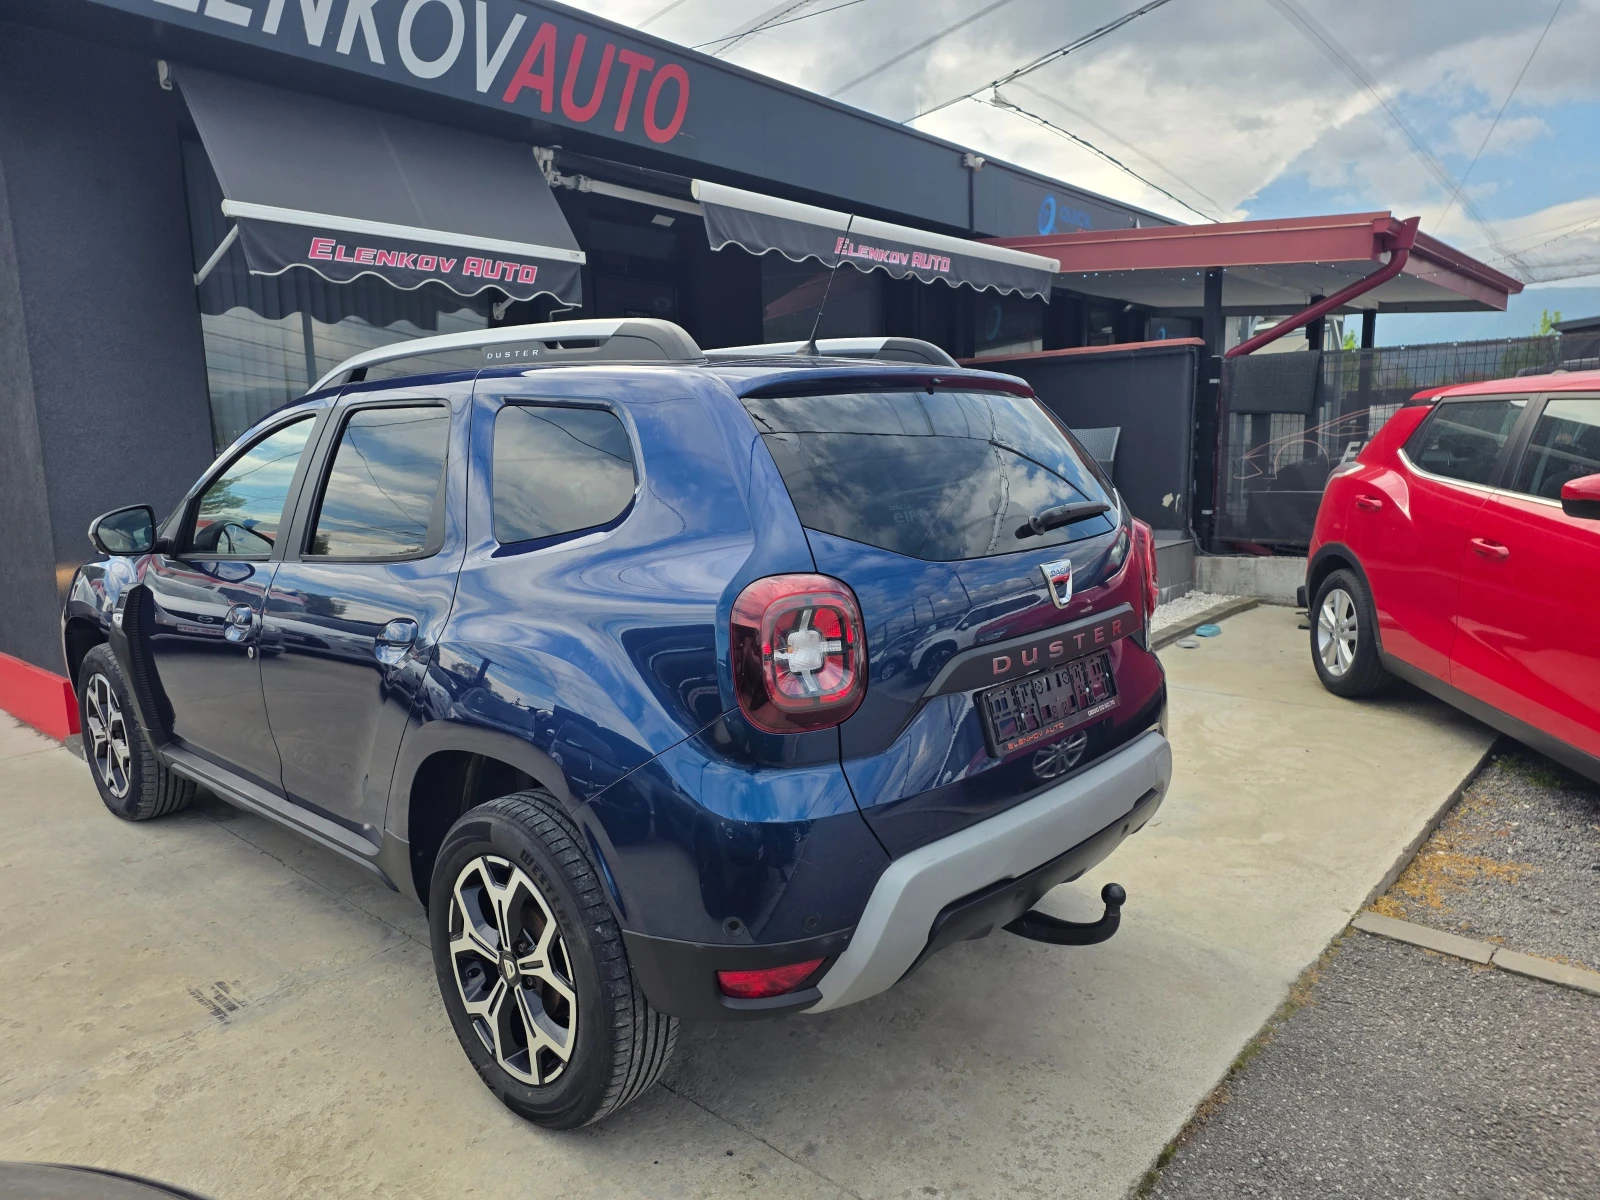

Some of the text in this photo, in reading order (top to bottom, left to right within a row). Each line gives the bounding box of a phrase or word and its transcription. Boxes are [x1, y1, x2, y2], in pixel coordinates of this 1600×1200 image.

[308, 237, 538, 284] ELENKOV AUTO
[834, 236, 951, 273] ELENKOV AUTO
[486, 349, 539, 360] DUSTER
[992, 619, 1122, 675] DUSTER
[1045, 722, 1065, 735] AUTO
